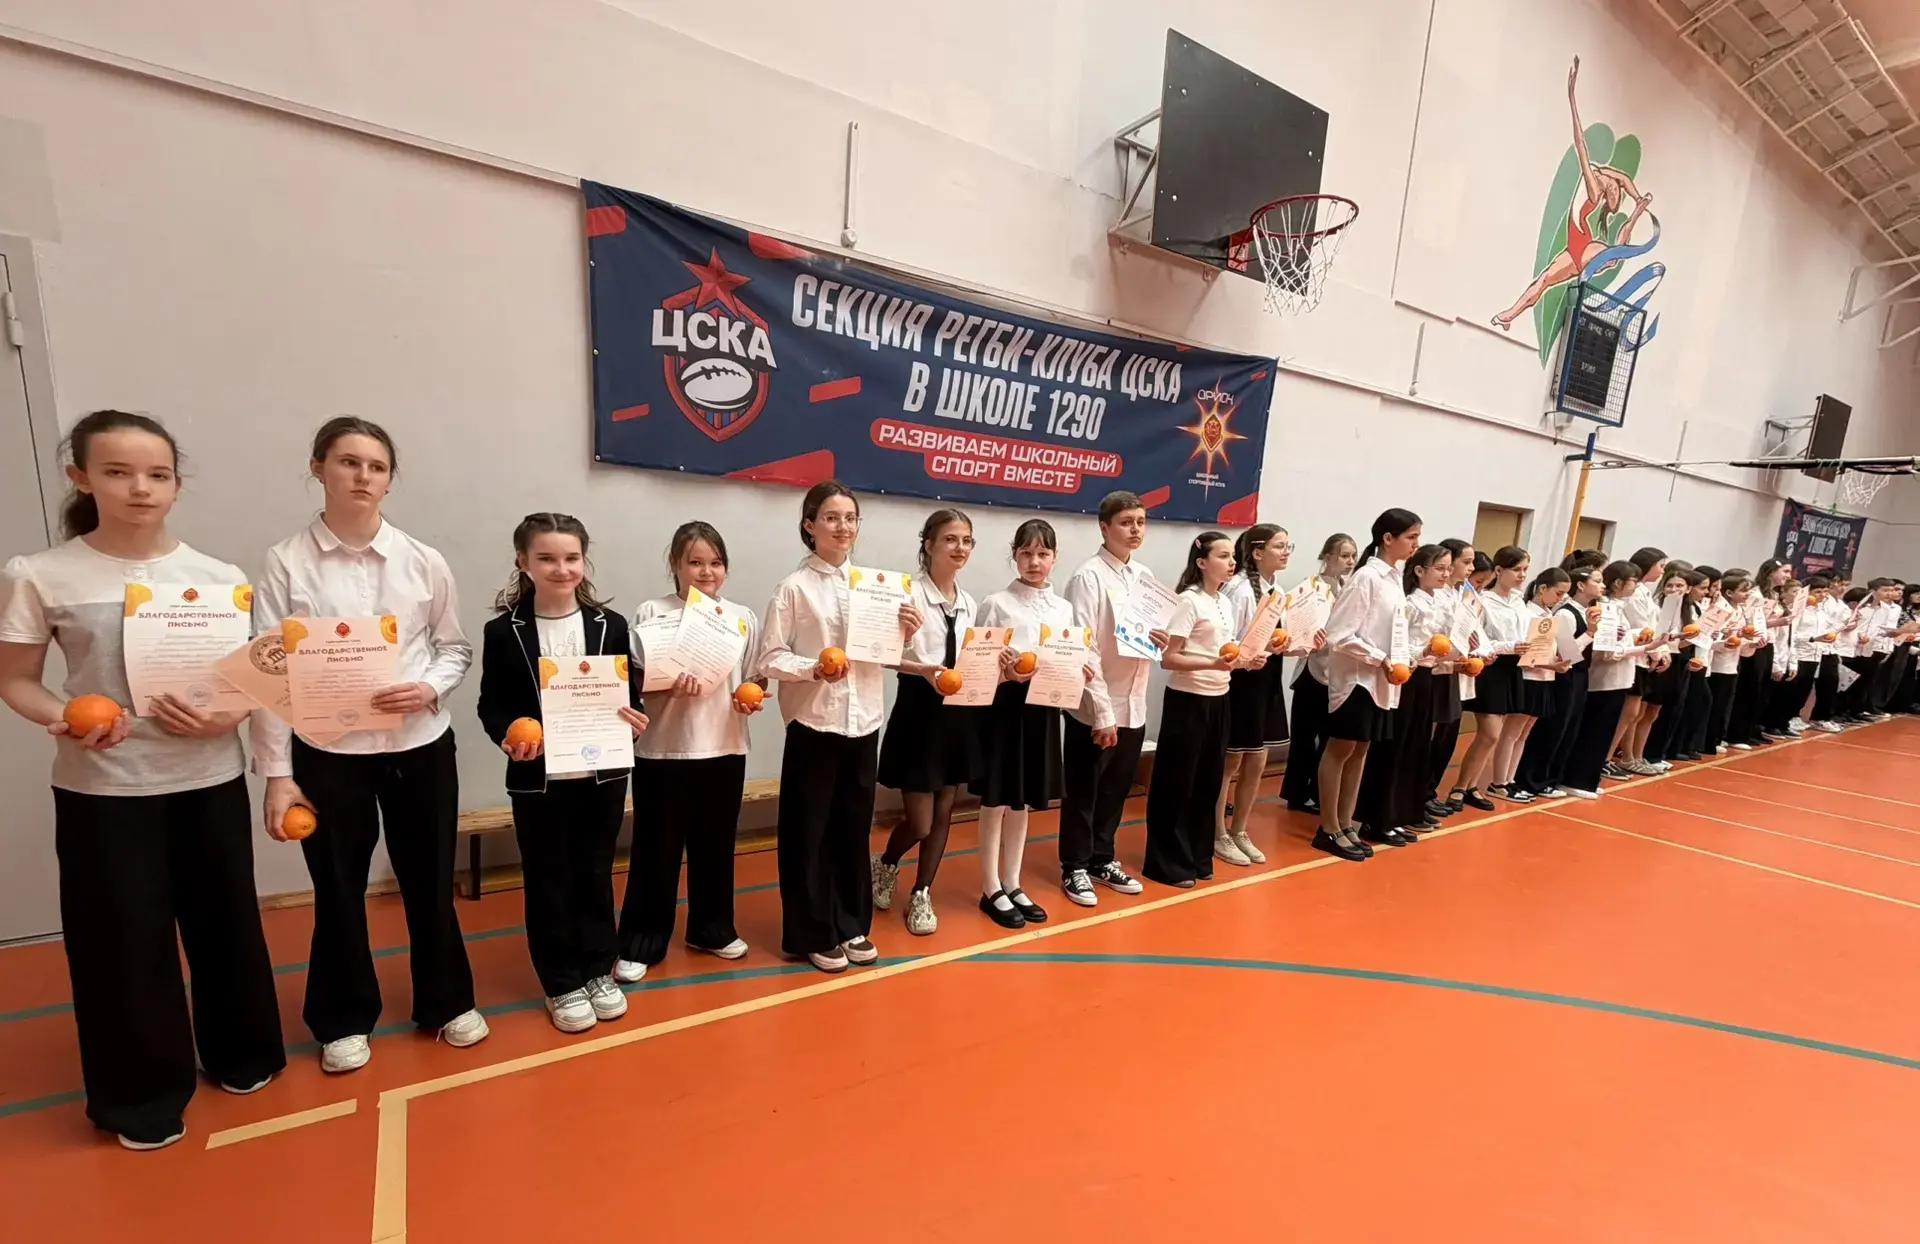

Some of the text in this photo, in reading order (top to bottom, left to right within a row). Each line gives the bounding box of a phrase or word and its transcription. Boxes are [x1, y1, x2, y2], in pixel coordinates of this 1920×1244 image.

[651, 308, 777, 369] ЦСКА
[792, 273, 1183, 403] СЕКЦИЯ РЕГБИ-КЛУБА ЦСКА
[902, 361, 1107, 441] В ШКОЛЕ 1290
[879, 424, 1118, 473] РАЗВИВАЕМ ШКОЛЬНЫЙ
[931, 456, 1076, 488] СПОРТ ВМЕСТЕ
[298, 645, 388, 655] БЛАГОДАРСТВЕННОЕ
[326, 655, 364, 663] ПИСЬМО
